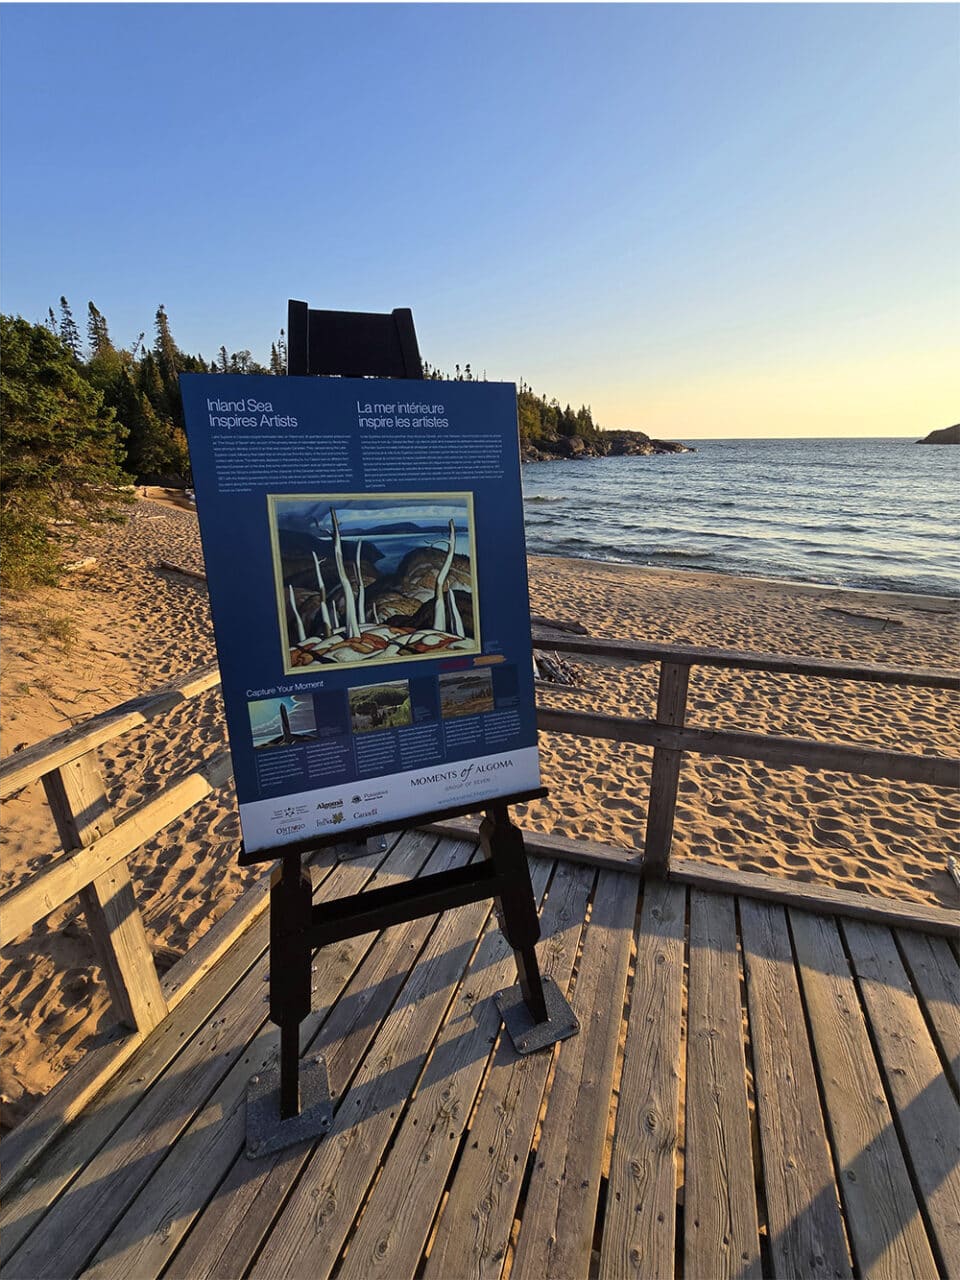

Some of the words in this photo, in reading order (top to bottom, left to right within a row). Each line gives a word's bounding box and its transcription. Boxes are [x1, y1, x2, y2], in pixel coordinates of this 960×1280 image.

[207, 398, 245, 412] Inland
[247, 399, 273, 412] Sea
[357, 401, 373, 414] La
[374, 403, 396, 414] mer
[397, 402, 444, 414] intérieure
[209, 414, 257, 429] Inspires
[260, 414, 298, 427] Artists
[358, 415, 393, 429] inspire
[395, 415, 411, 428] les
[412, 415, 449, 428] artistes
[246, 688, 276, 698] Capture
[276, 684, 294, 693] Your
[294, 680, 325, 690] Moment
[410, 770, 458, 787] MOMENTS
[460, 763, 474, 782] of
[475, 759, 514, 774] ALGOMA
